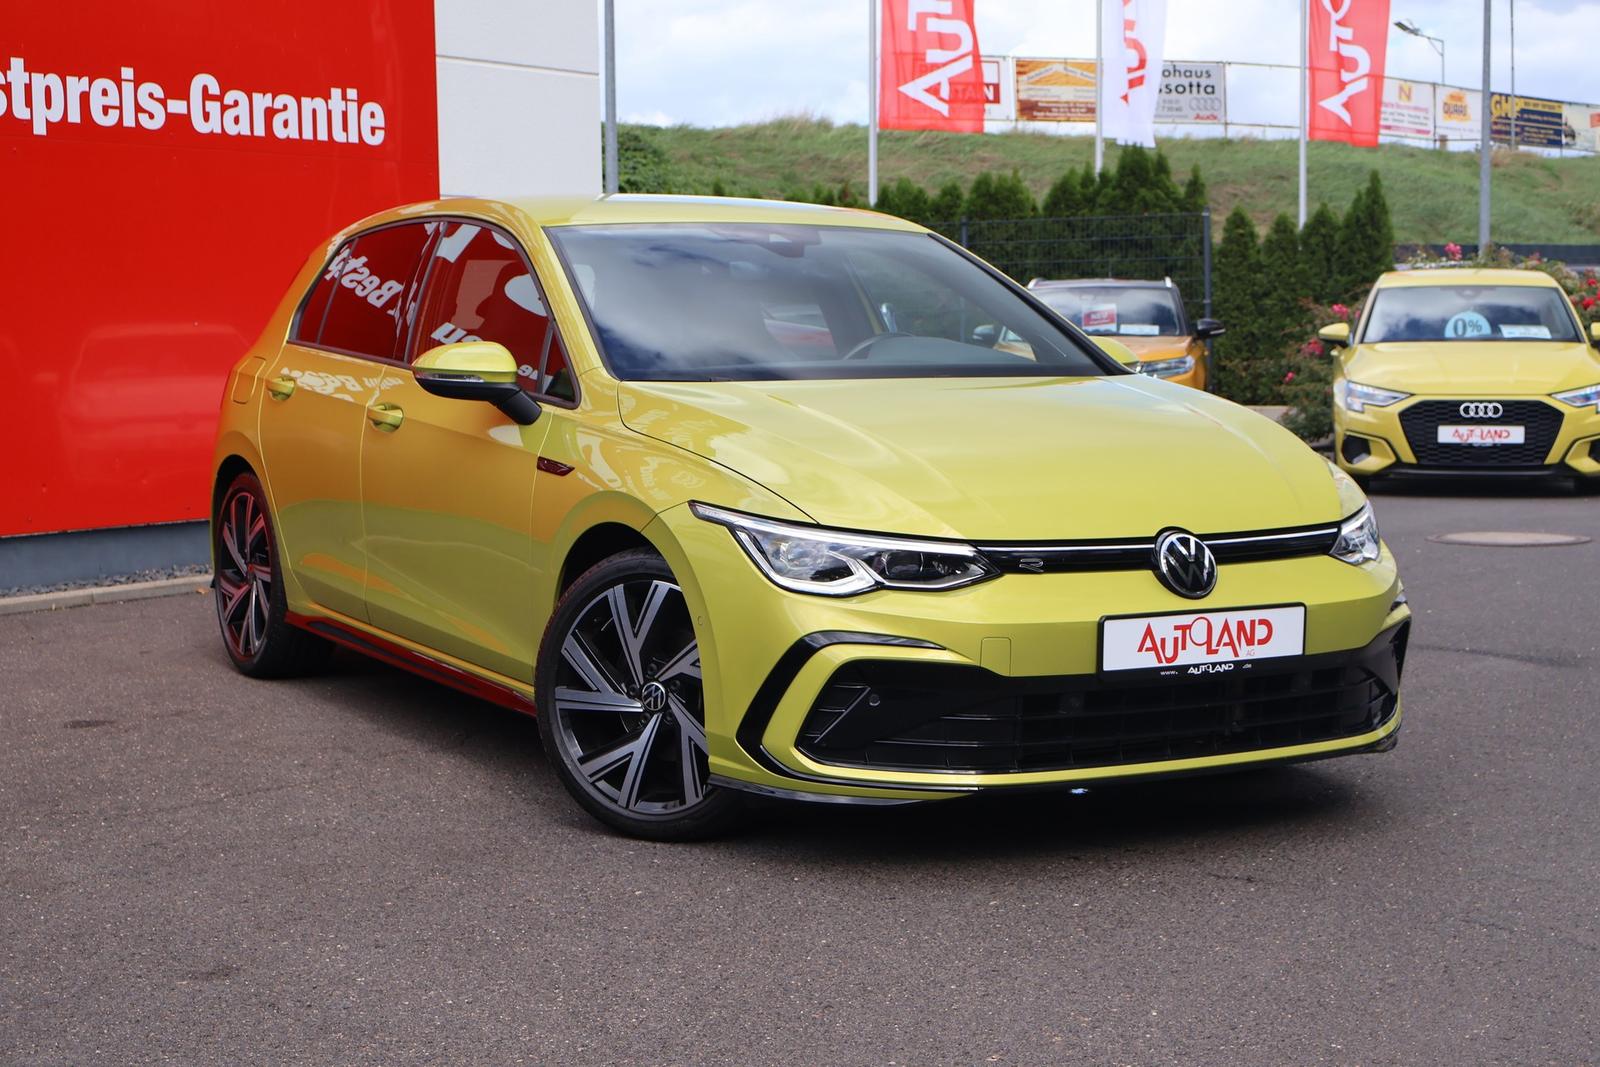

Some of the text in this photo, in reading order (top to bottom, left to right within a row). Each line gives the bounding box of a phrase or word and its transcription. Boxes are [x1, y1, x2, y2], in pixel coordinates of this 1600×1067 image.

[1162, 65, 1212, 79] ohaus
[1453, 318, 1482, 338] 0%
[1137, 616, 1273, 664] AUTOLAND
[1187, 663, 1234, 675] AUTOLAND
